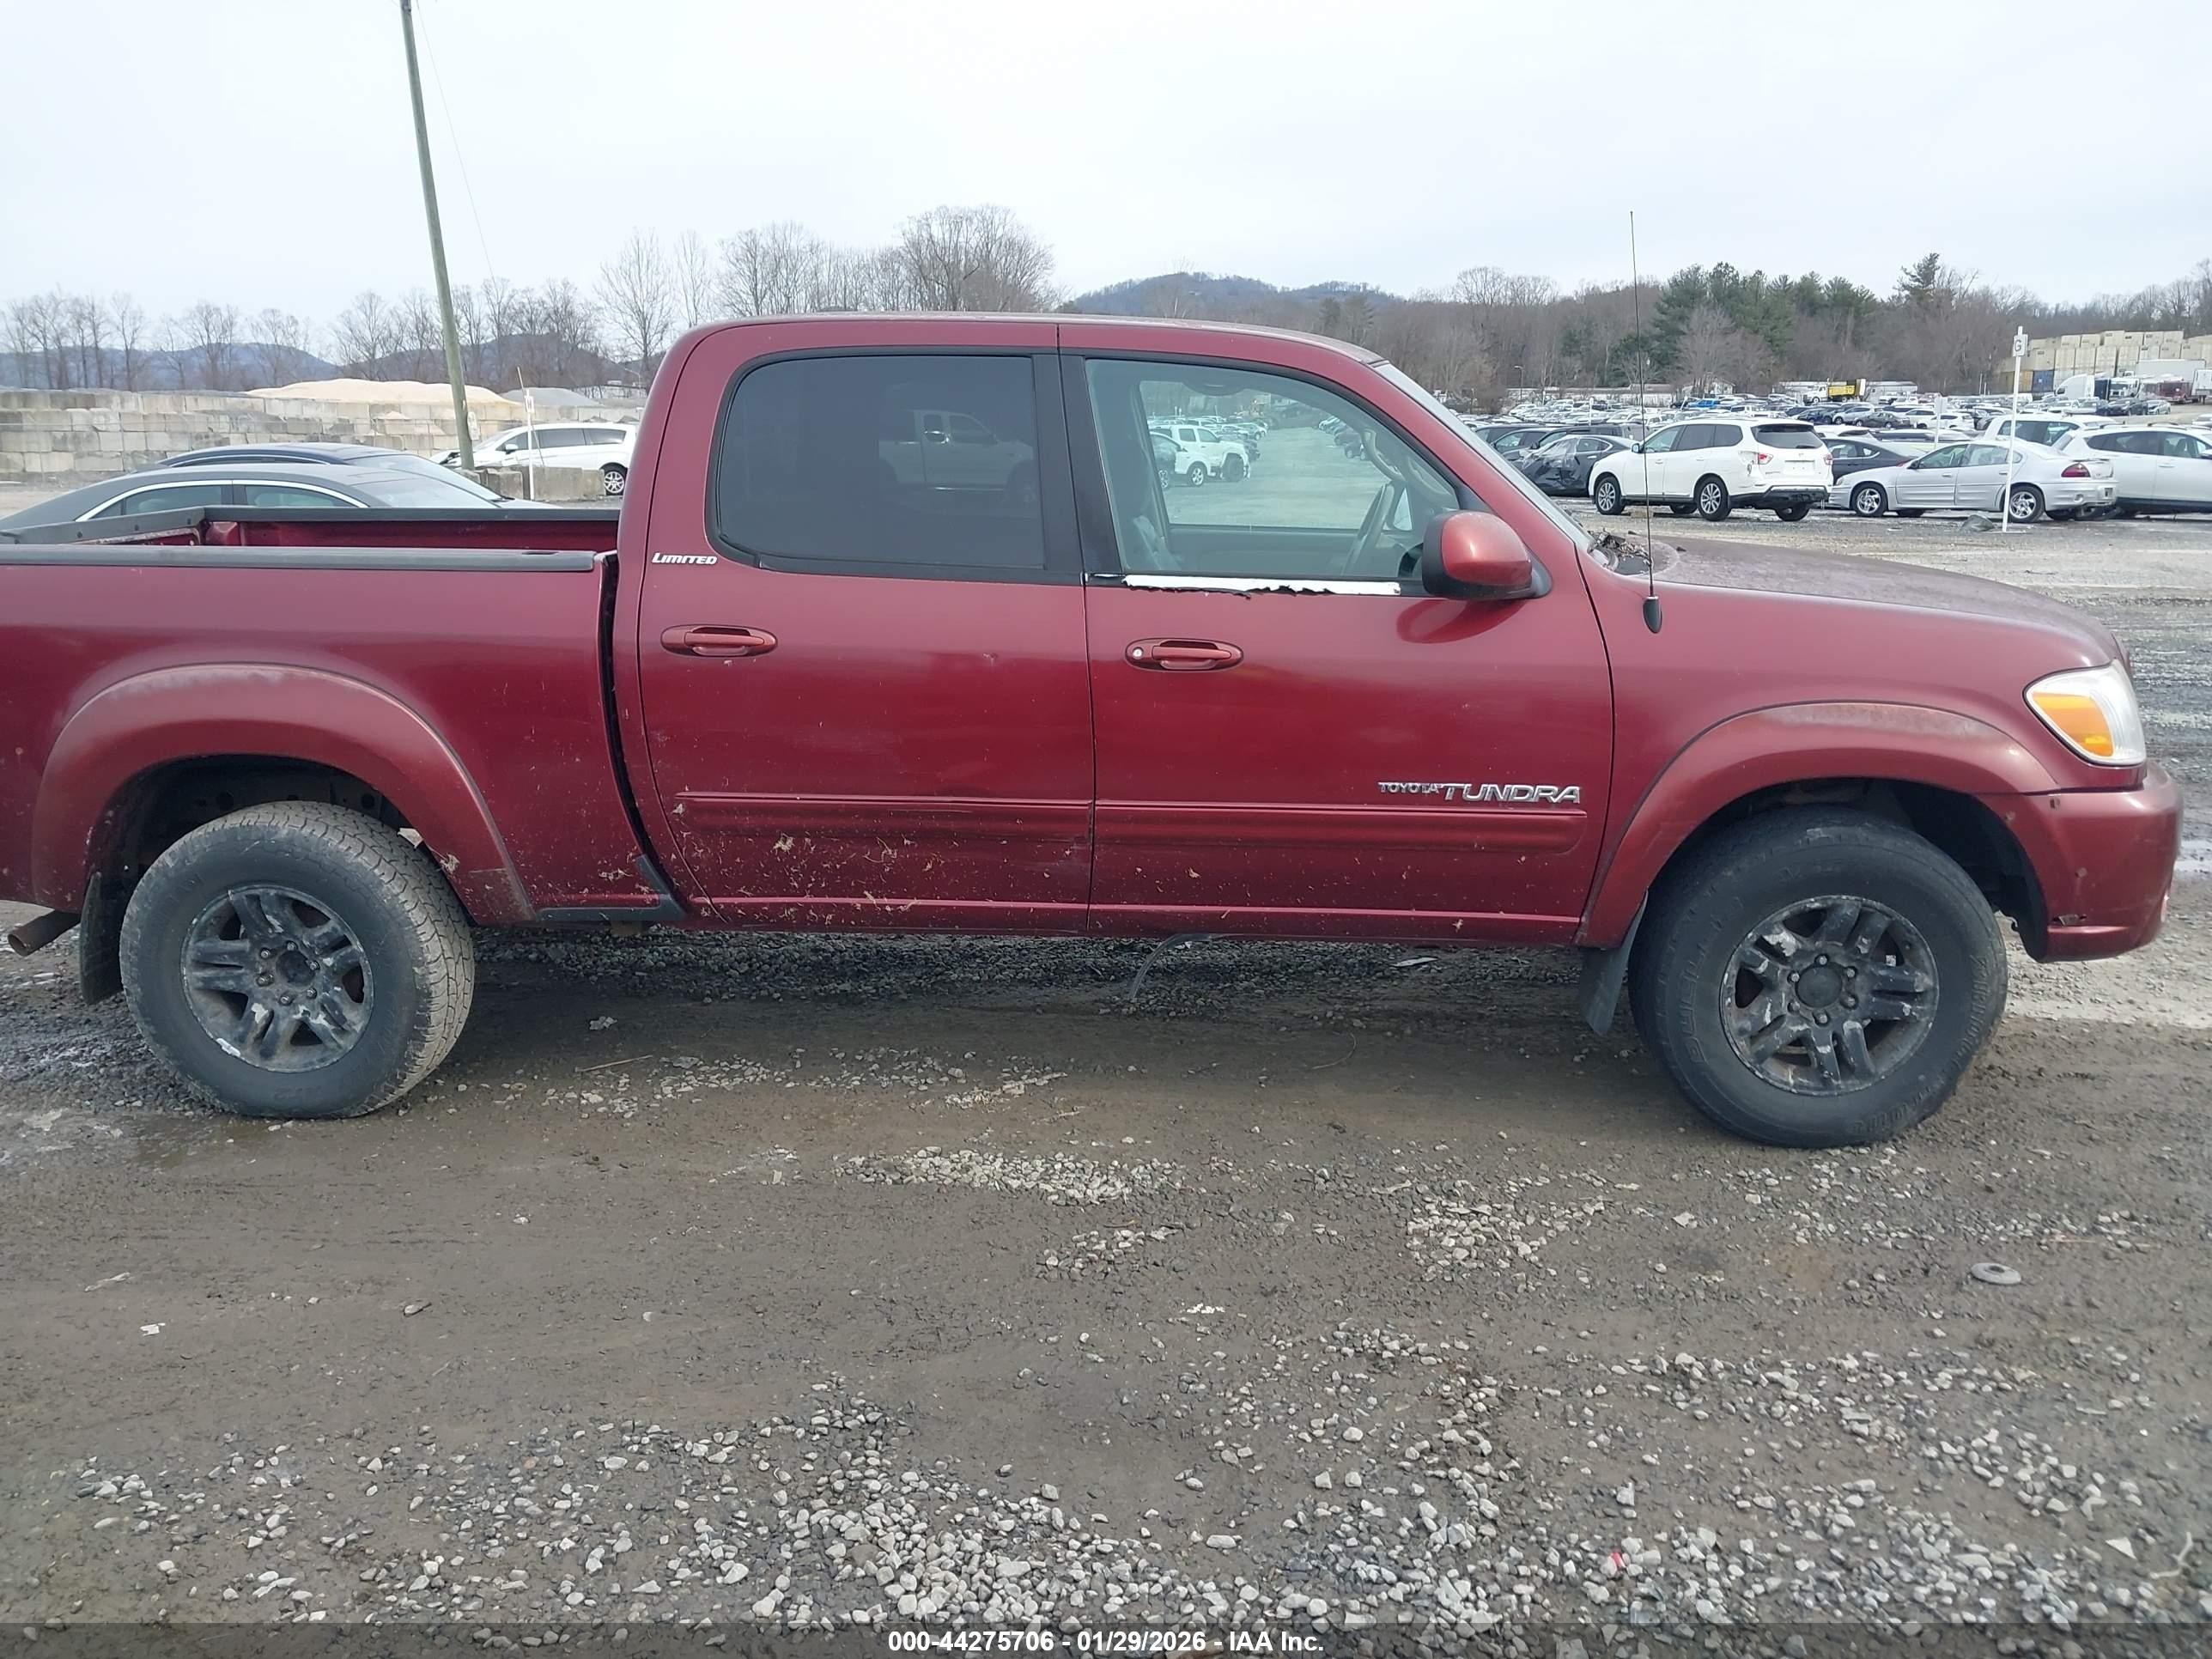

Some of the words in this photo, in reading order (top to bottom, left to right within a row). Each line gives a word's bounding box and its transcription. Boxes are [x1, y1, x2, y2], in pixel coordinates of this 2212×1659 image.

[2014, 339, 2022, 352] G
[1378, 781, 1440, 794] TOYOTA
[1443, 782, 1581, 804] TUNDRA
